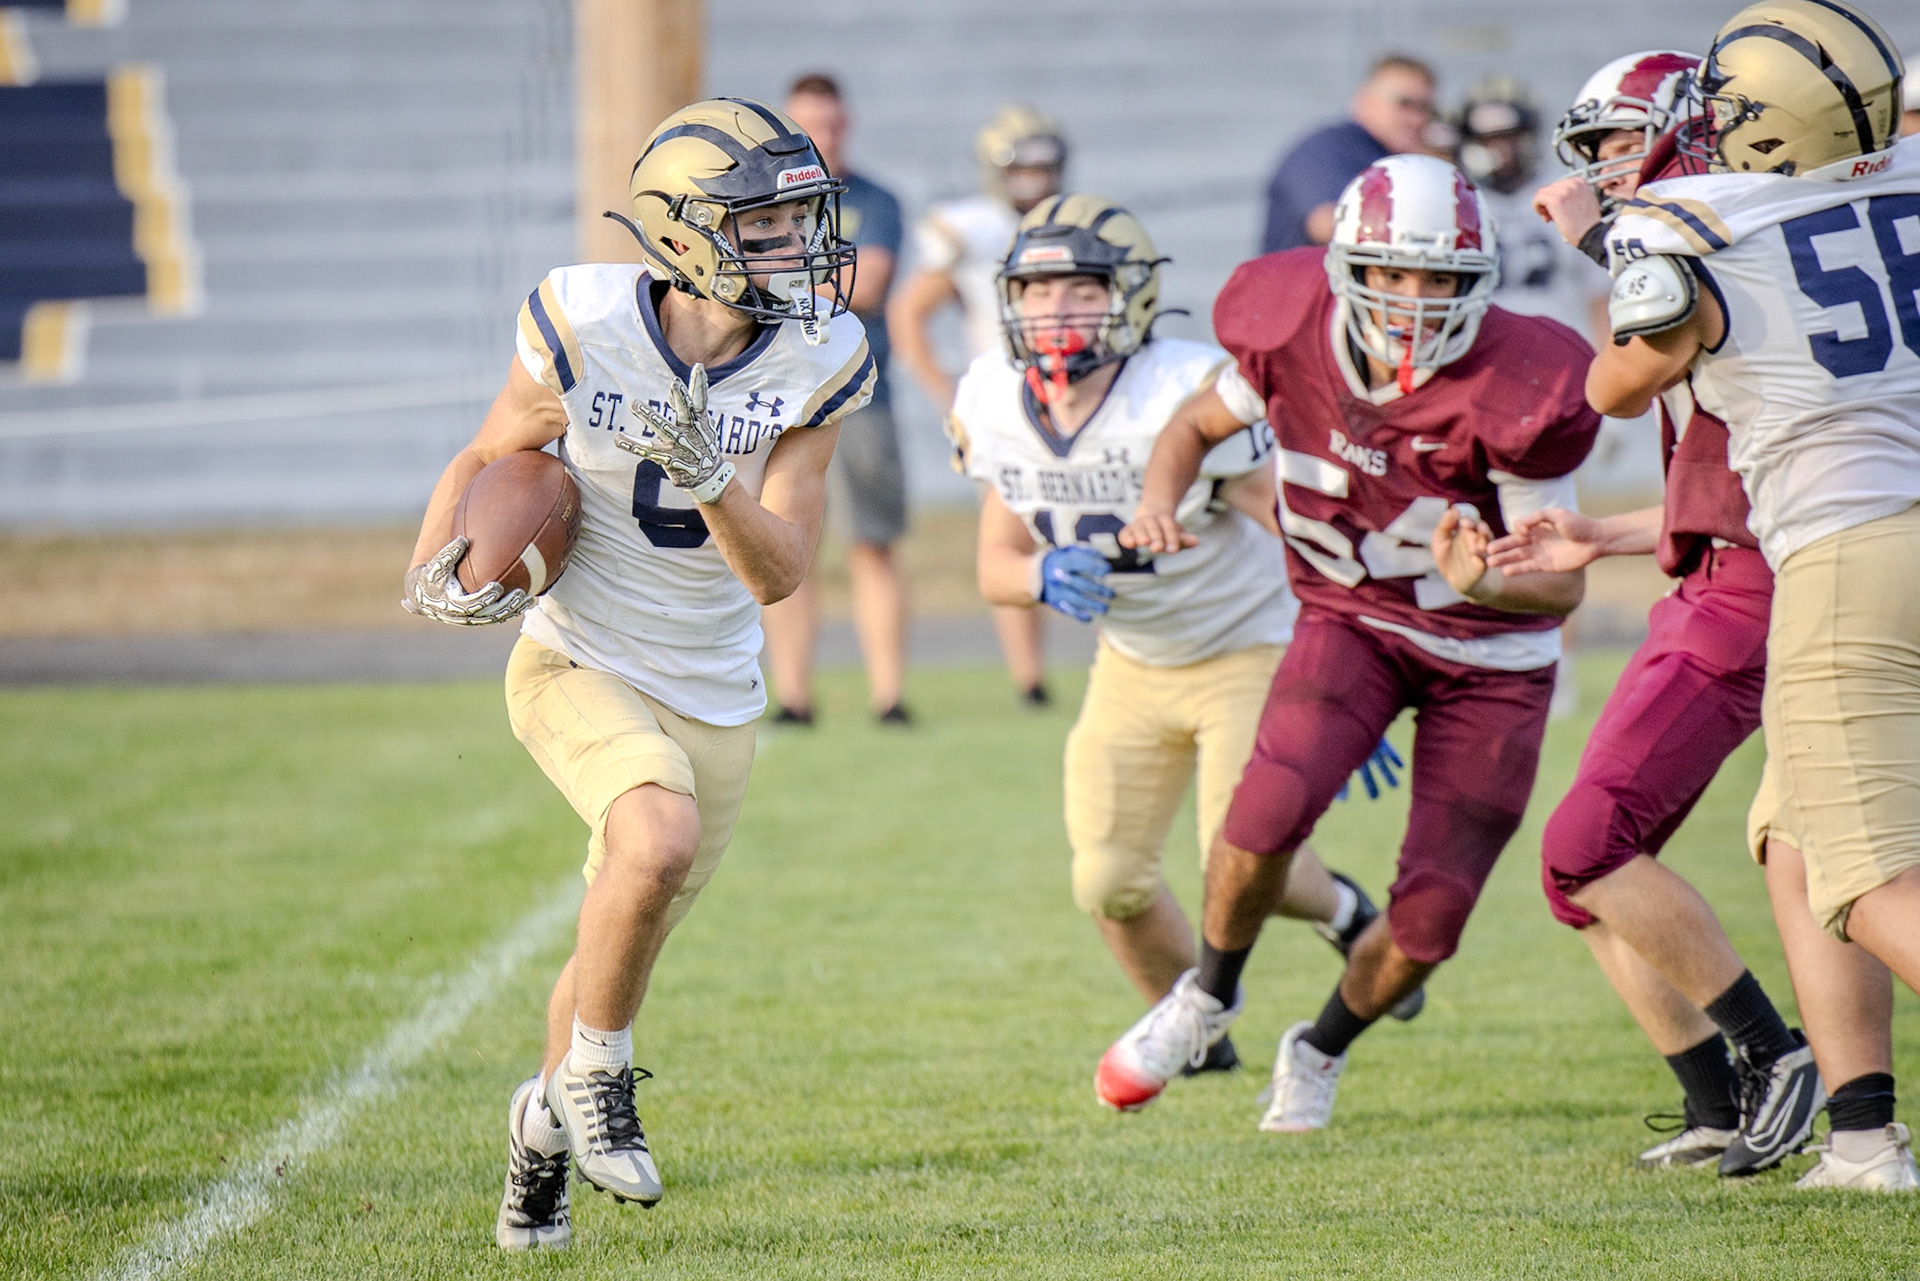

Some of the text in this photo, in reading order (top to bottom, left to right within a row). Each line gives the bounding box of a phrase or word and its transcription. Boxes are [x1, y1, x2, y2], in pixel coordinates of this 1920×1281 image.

[785, 168, 822, 183] Riddell
[589, 391, 624, 431] ST.
[1329, 428, 1387, 476] RAMS
[1275, 448, 1481, 610] 54
